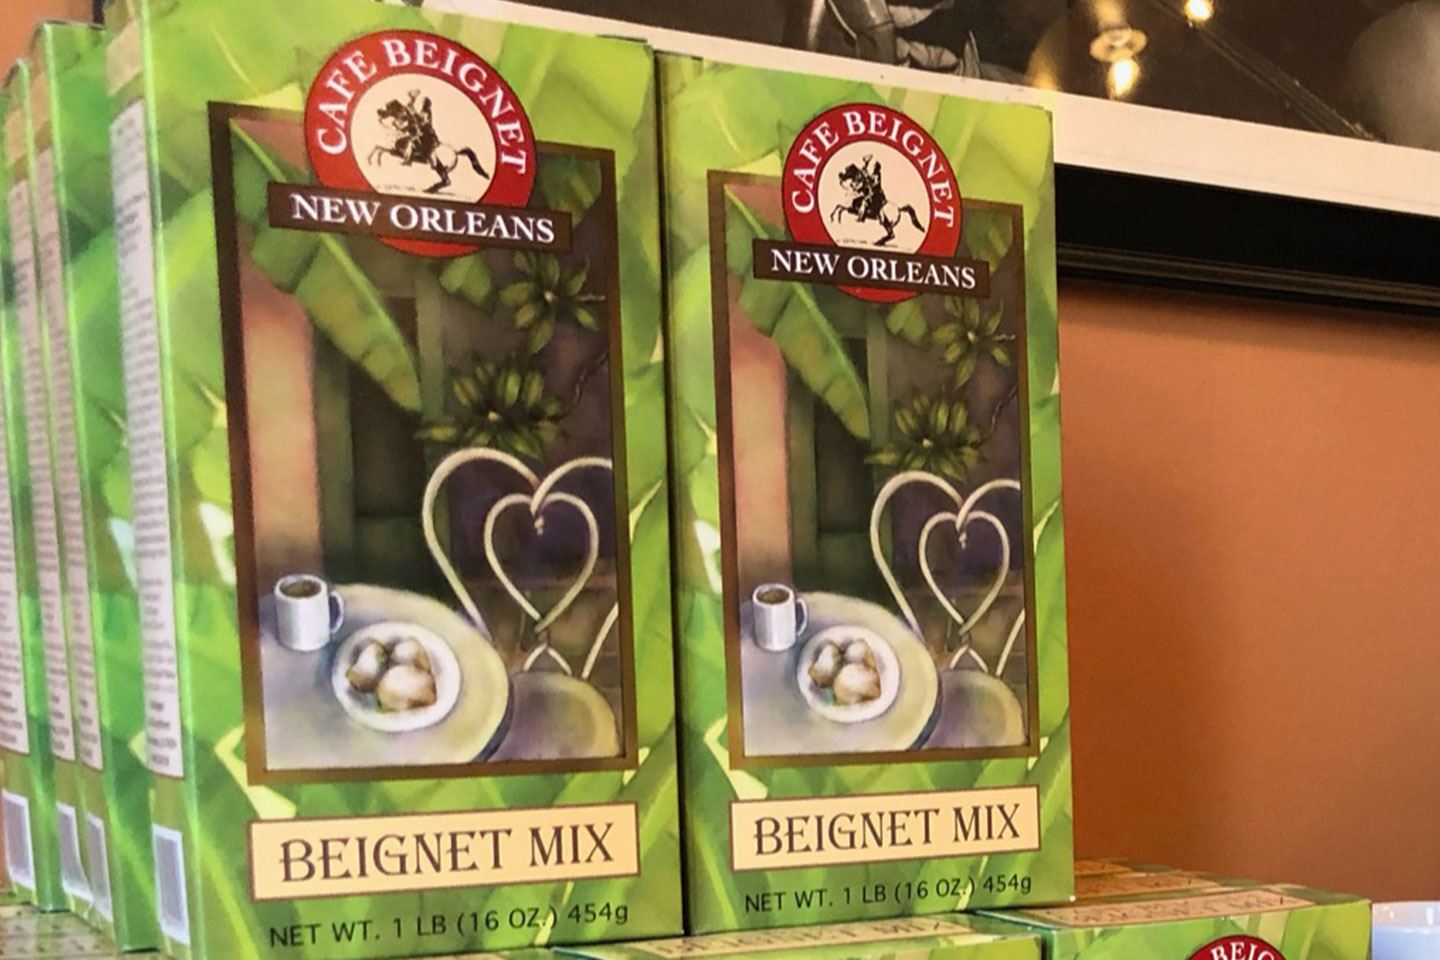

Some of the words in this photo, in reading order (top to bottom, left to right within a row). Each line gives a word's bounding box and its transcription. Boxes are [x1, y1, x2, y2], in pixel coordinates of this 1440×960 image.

[317, 50, 377, 155] CAFE
[382, 39, 527, 174] BEIGNET
[792, 122, 839, 213] CAFE
[843, 110, 955, 227] BEIGNET
[290, 193, 381, 226] NEW
[390, 204, 555, 243] ORLEANS
[771, 249, 840, 276] NEW
[847, 256, 976, 289] ORLEANS
[279, 828, 512, 884] BEIGNET
[529, 822, 614, 867] MIX
[753, 808, 940, 856] BEIGNET
[953, 803, 1020, 843] MIX
[745, 892, 786, 914] NET
[794, 888, 833, 909] WT.
[843, 886, 851, 905] 1
[862, 885, 886, 904] LB
[894, 881, 928, 905] (16
[983, 873, 1032, 894] 454g
[269, 923, 321, 948] NET
[331, 919, 380, 943] WT.
[393, 917, 402, 939] 1
[417, 913, 447, 937] LB
[456, 909, 499, 937] (16
[567, 903, 629, 926] 454g
